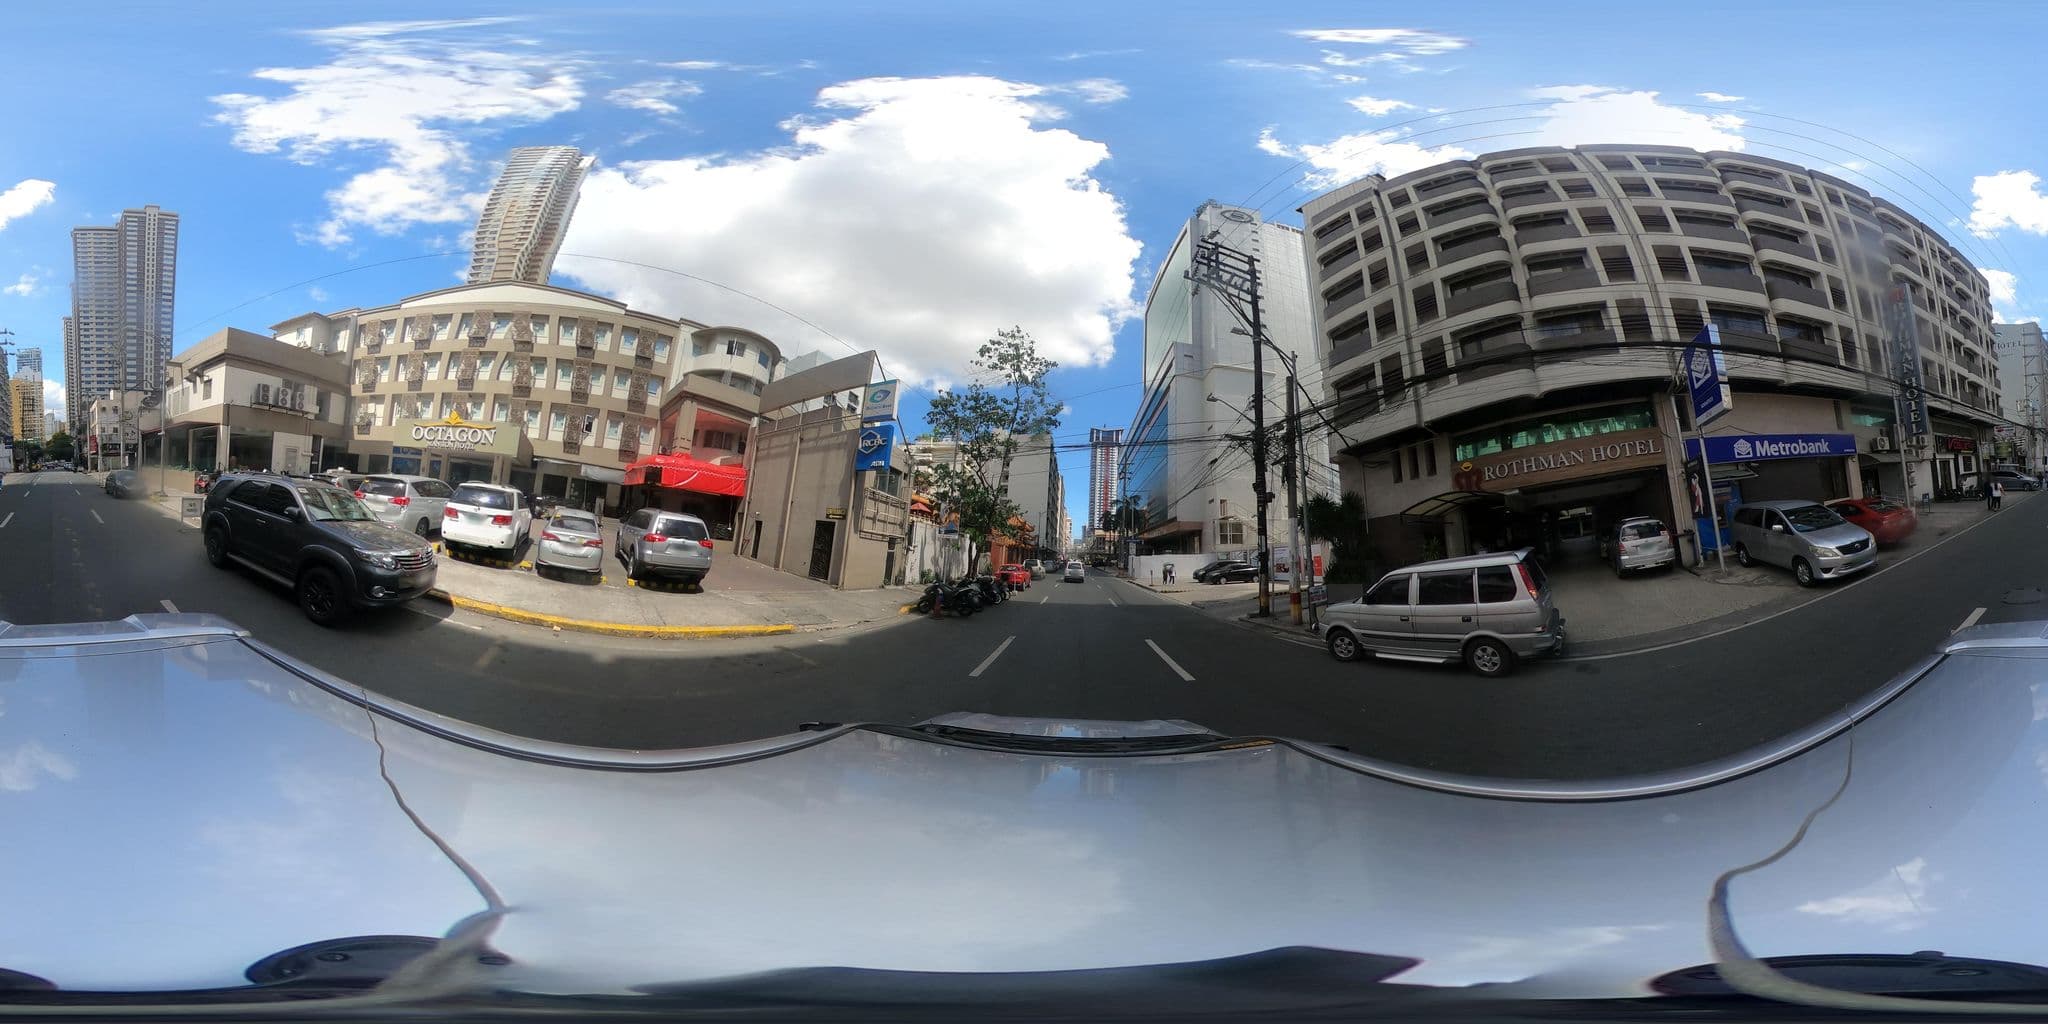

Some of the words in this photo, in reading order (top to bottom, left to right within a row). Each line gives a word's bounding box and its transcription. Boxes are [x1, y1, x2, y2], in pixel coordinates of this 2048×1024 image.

[412, 426, 496, 445] OCTAGON
[862, 437, 888, 448] RCBC
[1755, 439, 1831, 457] Metrobank
[1484, 448, 1584, 481] ROTHMAN
[1591, 438, 1661, 462] HOTEL
